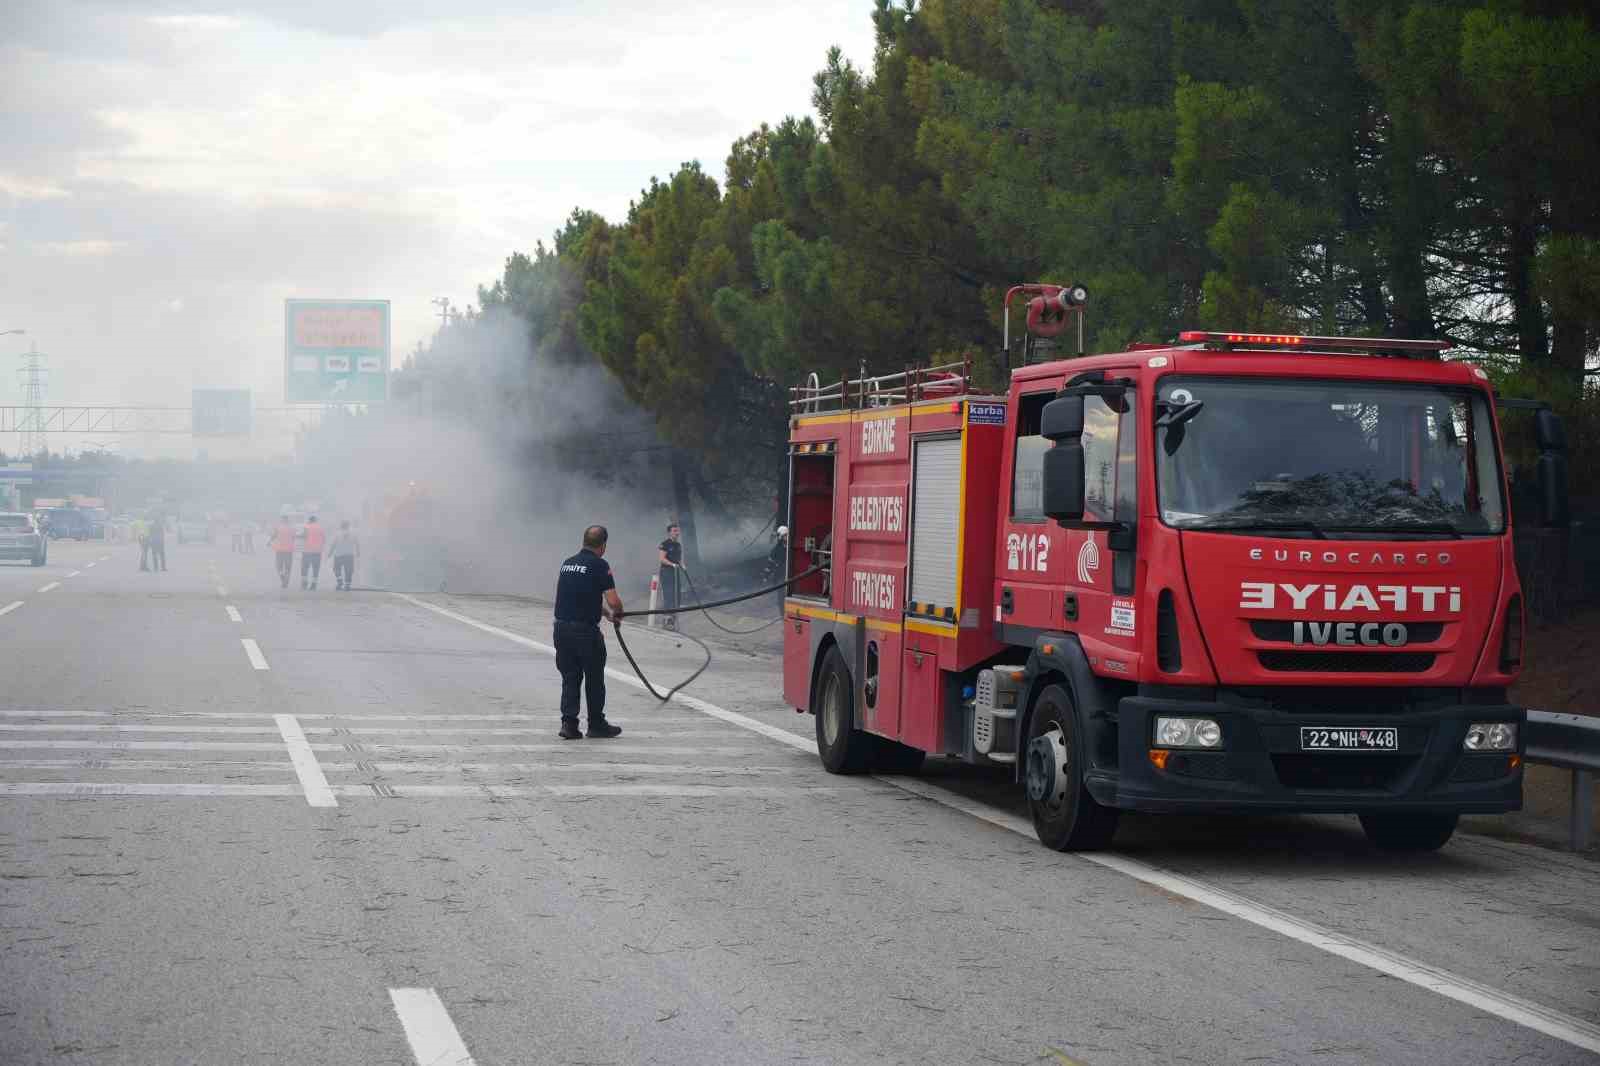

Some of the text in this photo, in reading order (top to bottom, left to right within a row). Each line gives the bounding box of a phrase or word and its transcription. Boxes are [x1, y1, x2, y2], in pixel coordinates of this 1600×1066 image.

[851, 496, 903, 532] BELEDİYESİ
[1020, 533, 1049, 572] 112
[1249, 548, 1452, 564] EUROCARGO
[1293, 621, 1409, 647] IVECO
[1309, 731, 1395, 748] 22 NH 448
